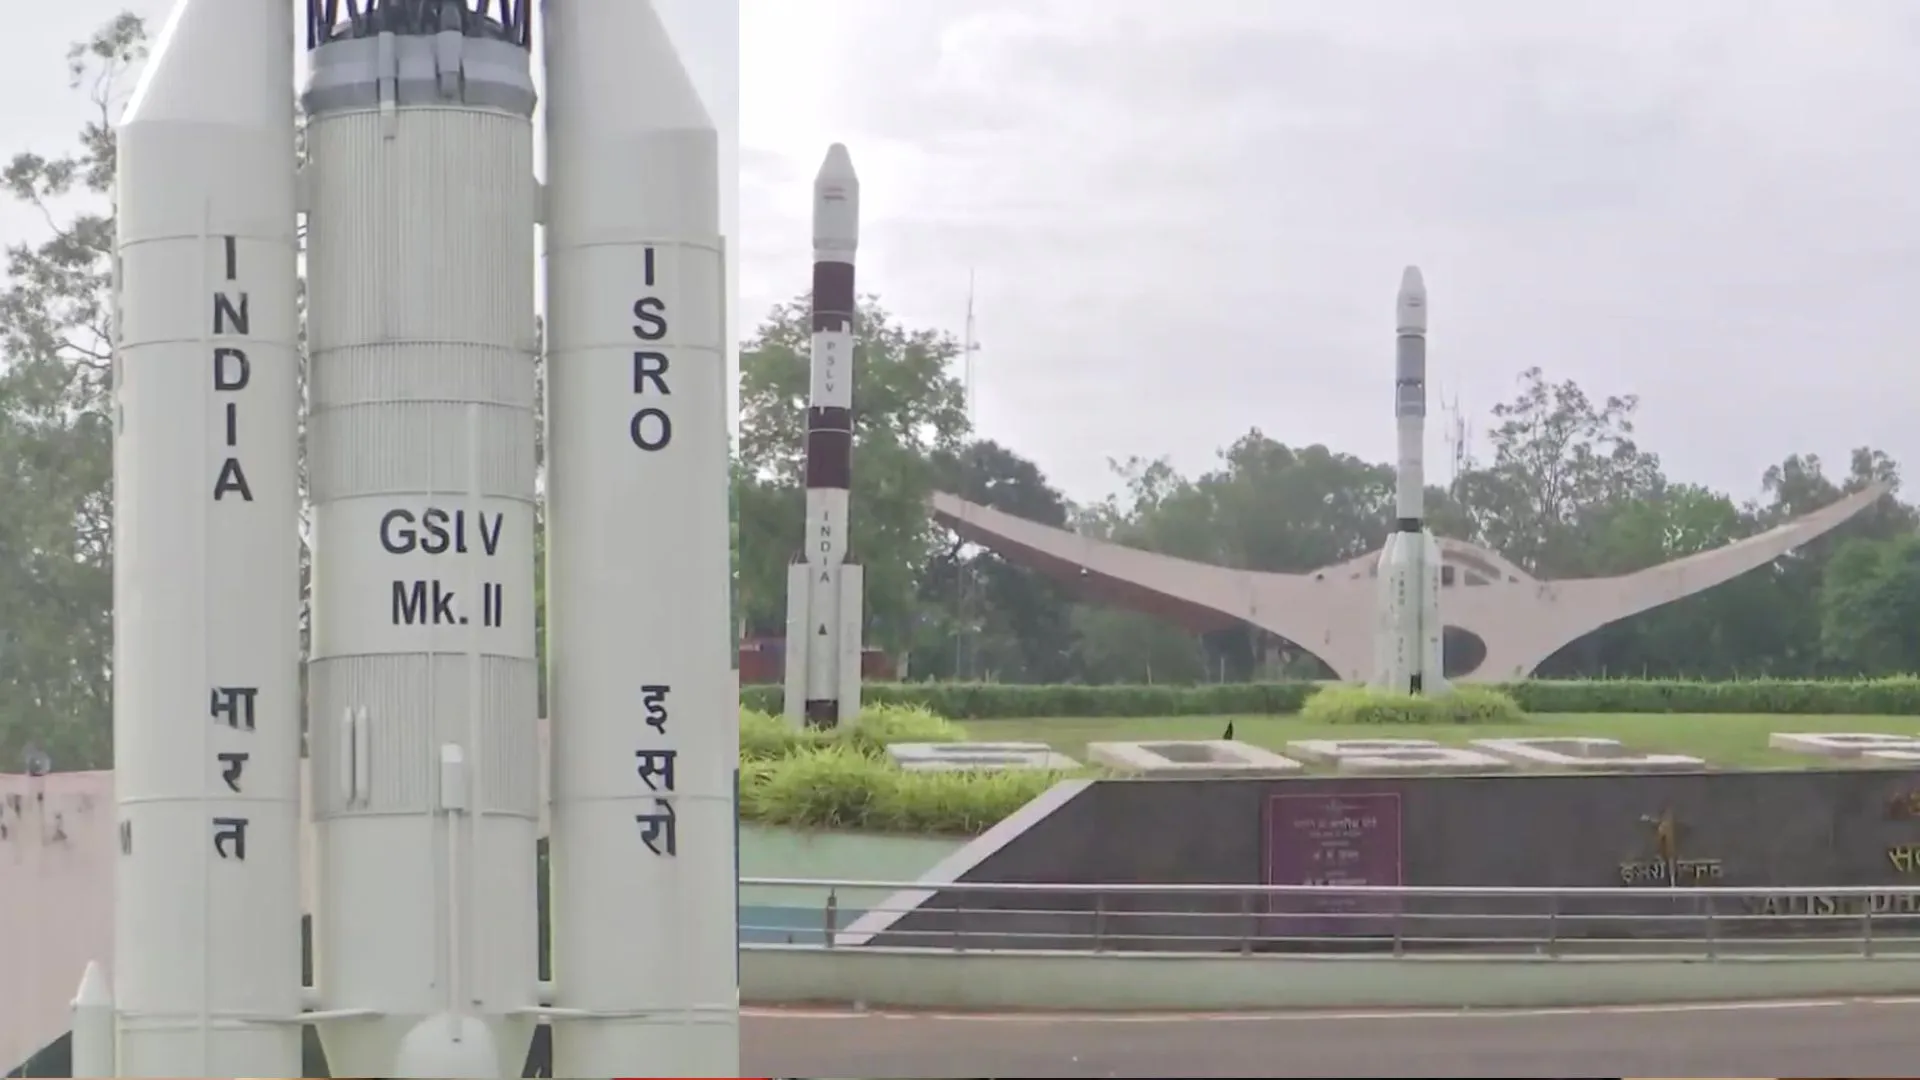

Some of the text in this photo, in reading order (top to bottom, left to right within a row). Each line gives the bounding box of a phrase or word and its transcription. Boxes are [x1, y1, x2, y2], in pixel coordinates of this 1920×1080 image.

[213, 235, 254, 501] INDIA
[629, 247, 672, 452] ISRO
[825, 340, 836, 393] PSLV
[391, 579, 503, 628] Mk. II
[819, 510, 830, 583] INDIA
[635, 684, 678, 857] इसरो
